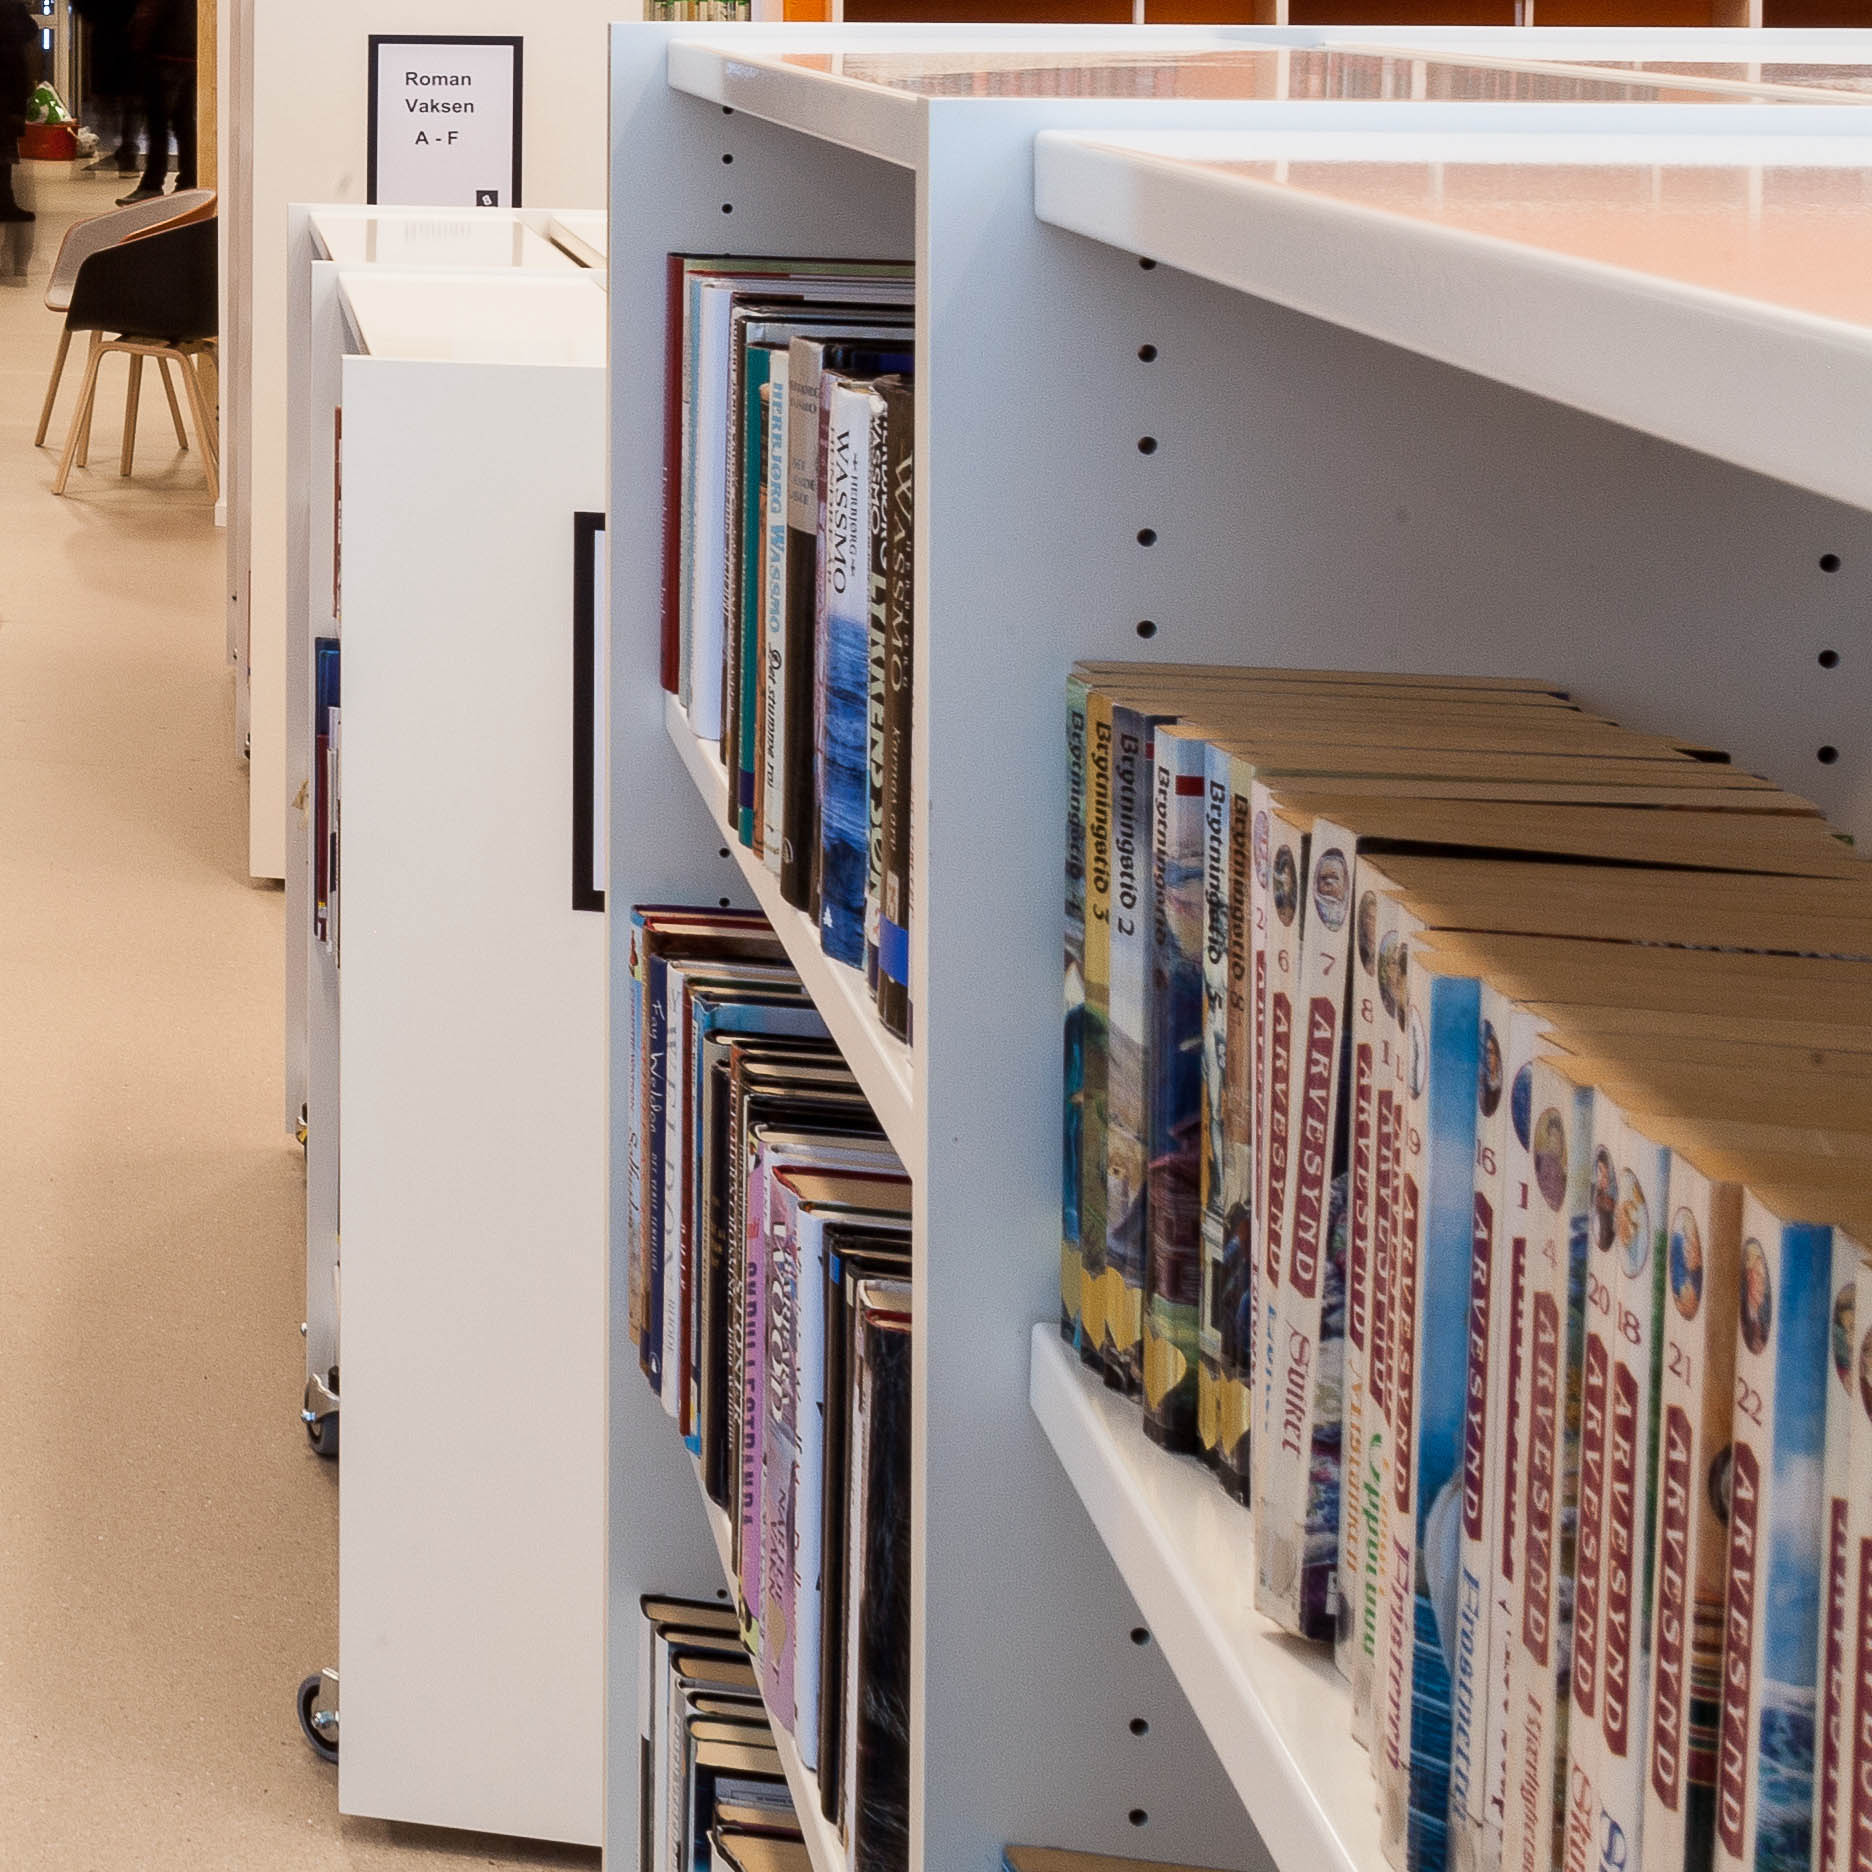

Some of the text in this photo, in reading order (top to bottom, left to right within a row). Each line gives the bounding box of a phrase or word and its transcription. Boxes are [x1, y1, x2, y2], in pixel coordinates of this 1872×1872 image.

[405, 72, 472, 86] Roman
[405, 98, 475, 113] Vaksen
[415, 131, 429, 145] A
[447, 131, 459, 145] F
[770, 382, 784, 516] HERBJØRG
[833, 429, 850, 594] WASSMO
[849, 474, 859, 555] HERBJØRG
[767, 641, 783, 685] Det
[768, 524, 785, 633] WASSMO
[890, 450, 913, 691] WASSMO
[767, 685, 777, 759] stumme
[870, 571, 885, 789] LYKKENS
[890, 726, 901, 805] Karnas
[1091, 720, 1112, 923] Brytningstid 3
[1115, 733, 1139, 936] Brytningstid 2
[1207, 779, 1226, 1010] Brytningstid 5
[1231, 792, 1250, 981] Brytningstid
[1319, 951, 1336, 976] 7
[649, 1052, 665, 1134] Weldon
[1269, 1009, 1289, 1270] ARVESYND
[1296, 1013, 1332, 1281] ARVESYND
[1476, 1138, 1497, 1176] 16
[1353, 1060, 1372, 1333] ARVESYND
[1588, 1273, 1611, 1316] 20
[770, 1222, 787, 1425] WOOD
[1396, 1192, 1416, 1493] ARVESYND
[1465, 1212, 1489, 1521] ARVESYND
[1530, 1311, 1556, 1655] ARVESYND
[1577, 1353, 1606, 1693] ARVESYND
[1606, 1301, 1642, 1732] 18 ARVESYND
[1656, 1341, 1692, 1793] 21 ARVESYND
[1722, 1376, 1763, 1836] 22 ARVESYND
[1520, 1692, 1543, 1872] Kjærlighets
